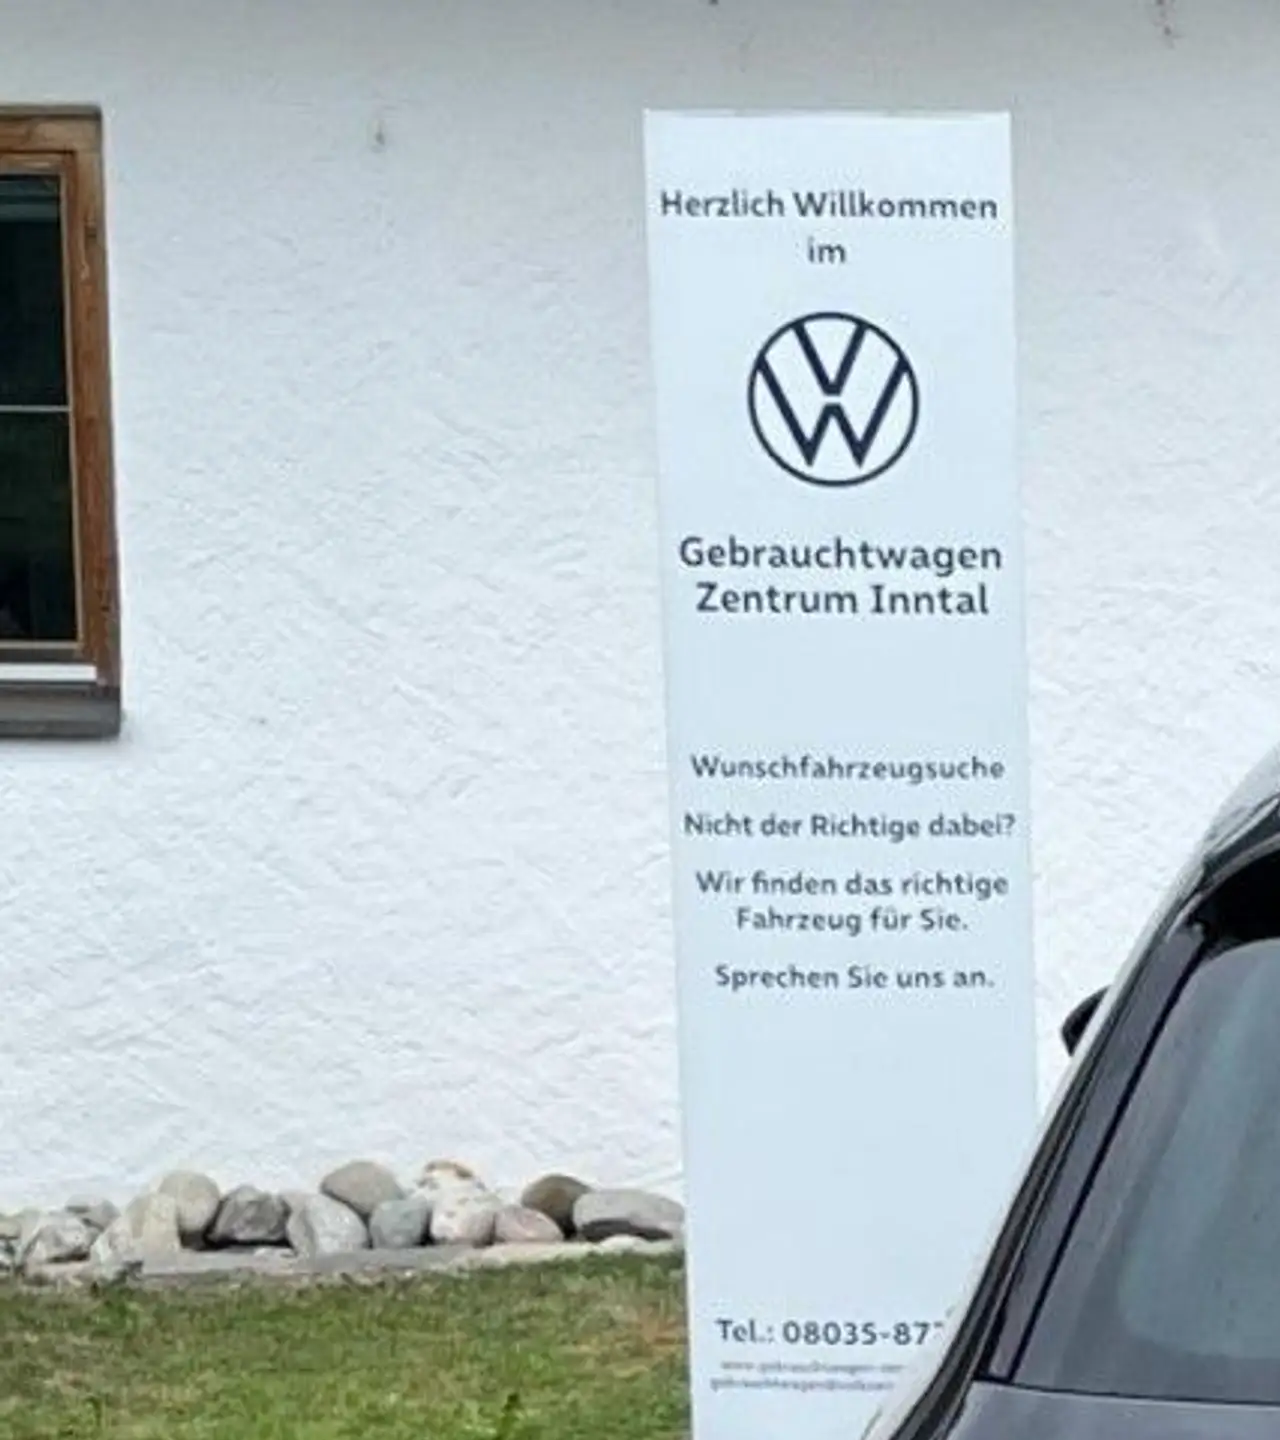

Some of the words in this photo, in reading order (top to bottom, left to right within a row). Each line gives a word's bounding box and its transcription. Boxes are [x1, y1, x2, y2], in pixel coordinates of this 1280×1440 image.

[660, 188, 785, 218] Herzlich
[791, 190, 998, 220] Willkommen
[806, 236, 848, 265] im
[679, 534, 1002, 578] Gebrauchtwagen
[696, 581, 859, 615] Zentrum
[870, 582, 990, 615] Inntal
[690, 753, 1005, 786] Wunschfahrzeugsuche
[683, 812, 753, 837] Nicht
[759, 812, 803, 837] der
[810, 812, 921, 844] Richtige
[927, 812, 1016, 838] dabei?
[695, 869, 746, 894] Wir
[751, 869, 837, 896] finden
[844, 871, 893, 896] das
[901, 871, 1009, 902] richtige
[736, 905, 862, 938] Fahrzeug
[869, 905, 913, 931] für
[919, 908, 968, 932] Sie.
[714, 963, 840, 993] Sprechen
[847, 964, 889, 989] Sie
[896, 971, 946, 990] uns
[952, 970, 995, 988] an.
[714, 1317, 774, 1343] Tel.:
[782, 1320, 945, 1346] 08035-87
